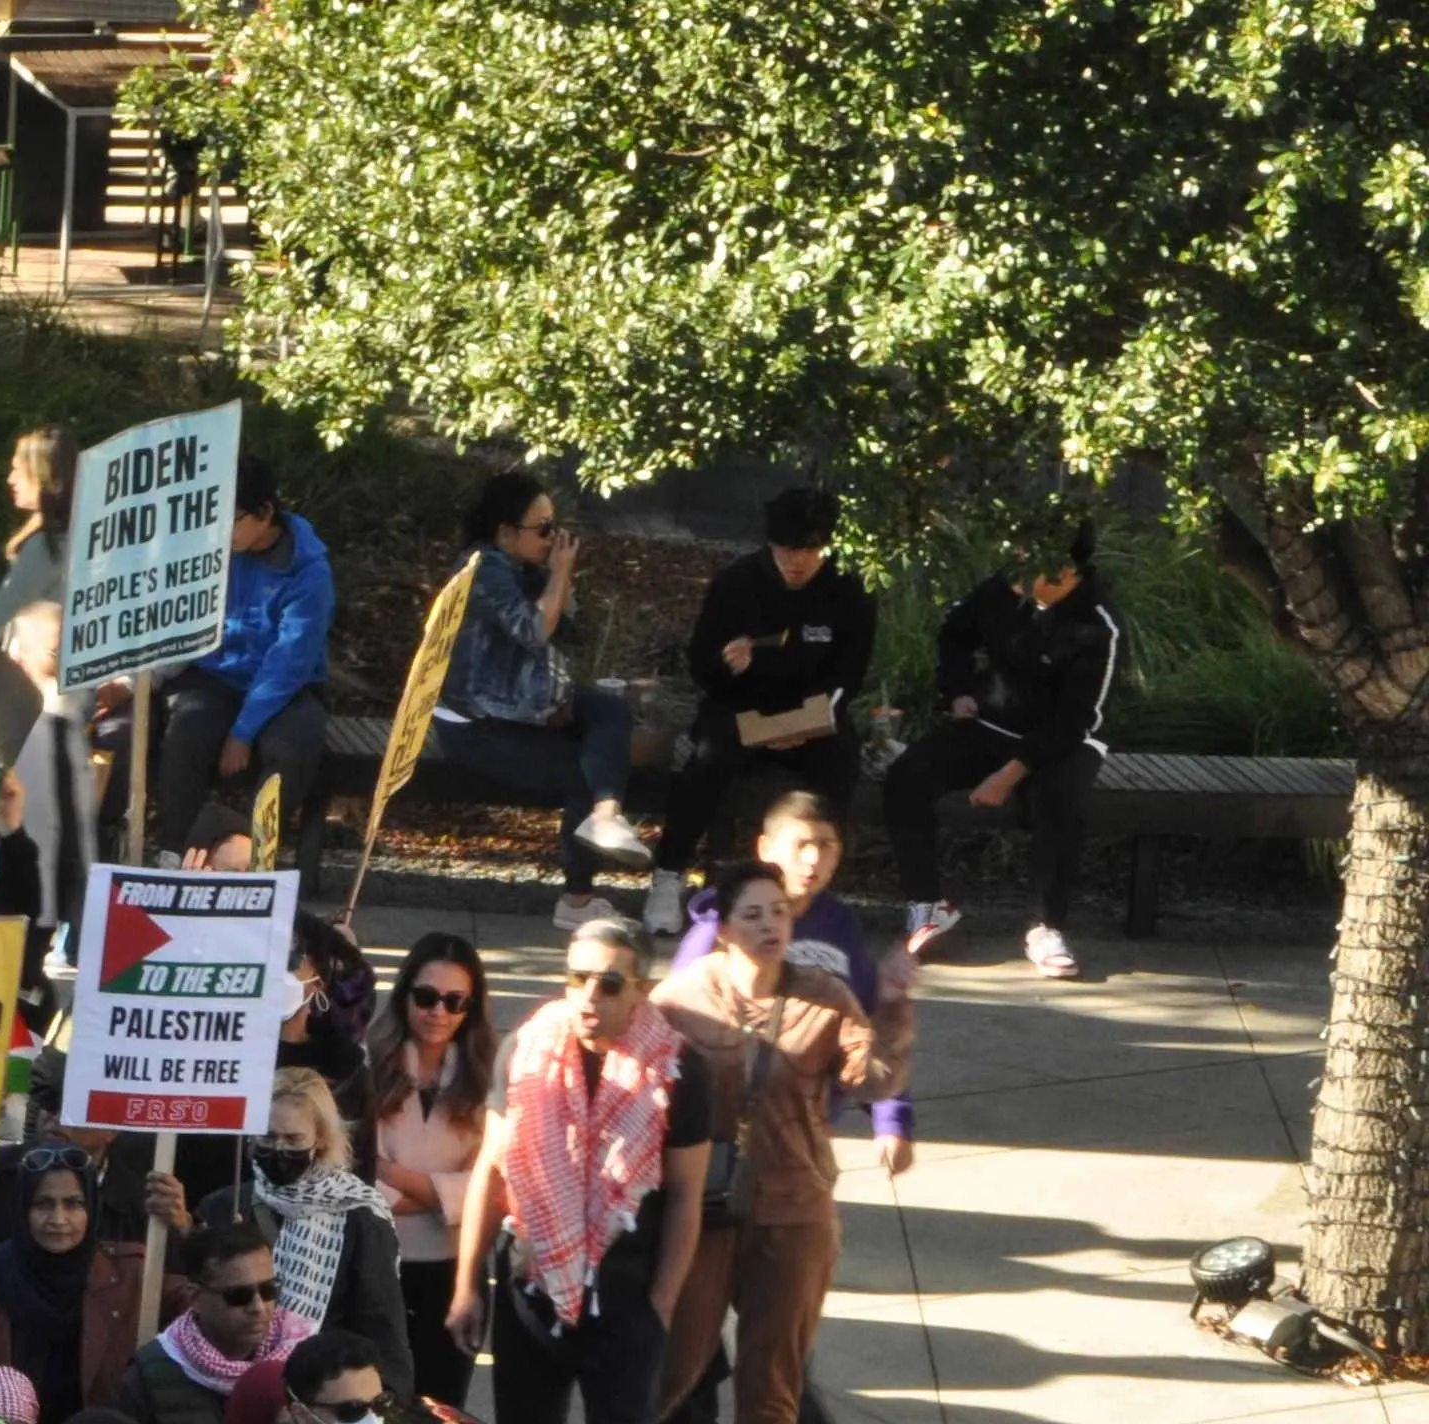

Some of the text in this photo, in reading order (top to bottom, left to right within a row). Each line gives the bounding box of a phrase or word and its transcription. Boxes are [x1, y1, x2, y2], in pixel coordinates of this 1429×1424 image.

[104, 435, 210, 505] BIDEN:
[87, 484, 221, 561] FUND THE
[72, 548, 223, 617] PEOPLE'S NEEDS
[71, 584, 220, 654] NOT GENOCIDE
[116, 881, 274, 911] FROM THE RIVER
[138, 964, 260, 995] TO THE SEA
[108, 1006, 246, 1042] PALESTINE
[104, 1054, 241, 1084] WILL BE FREE
